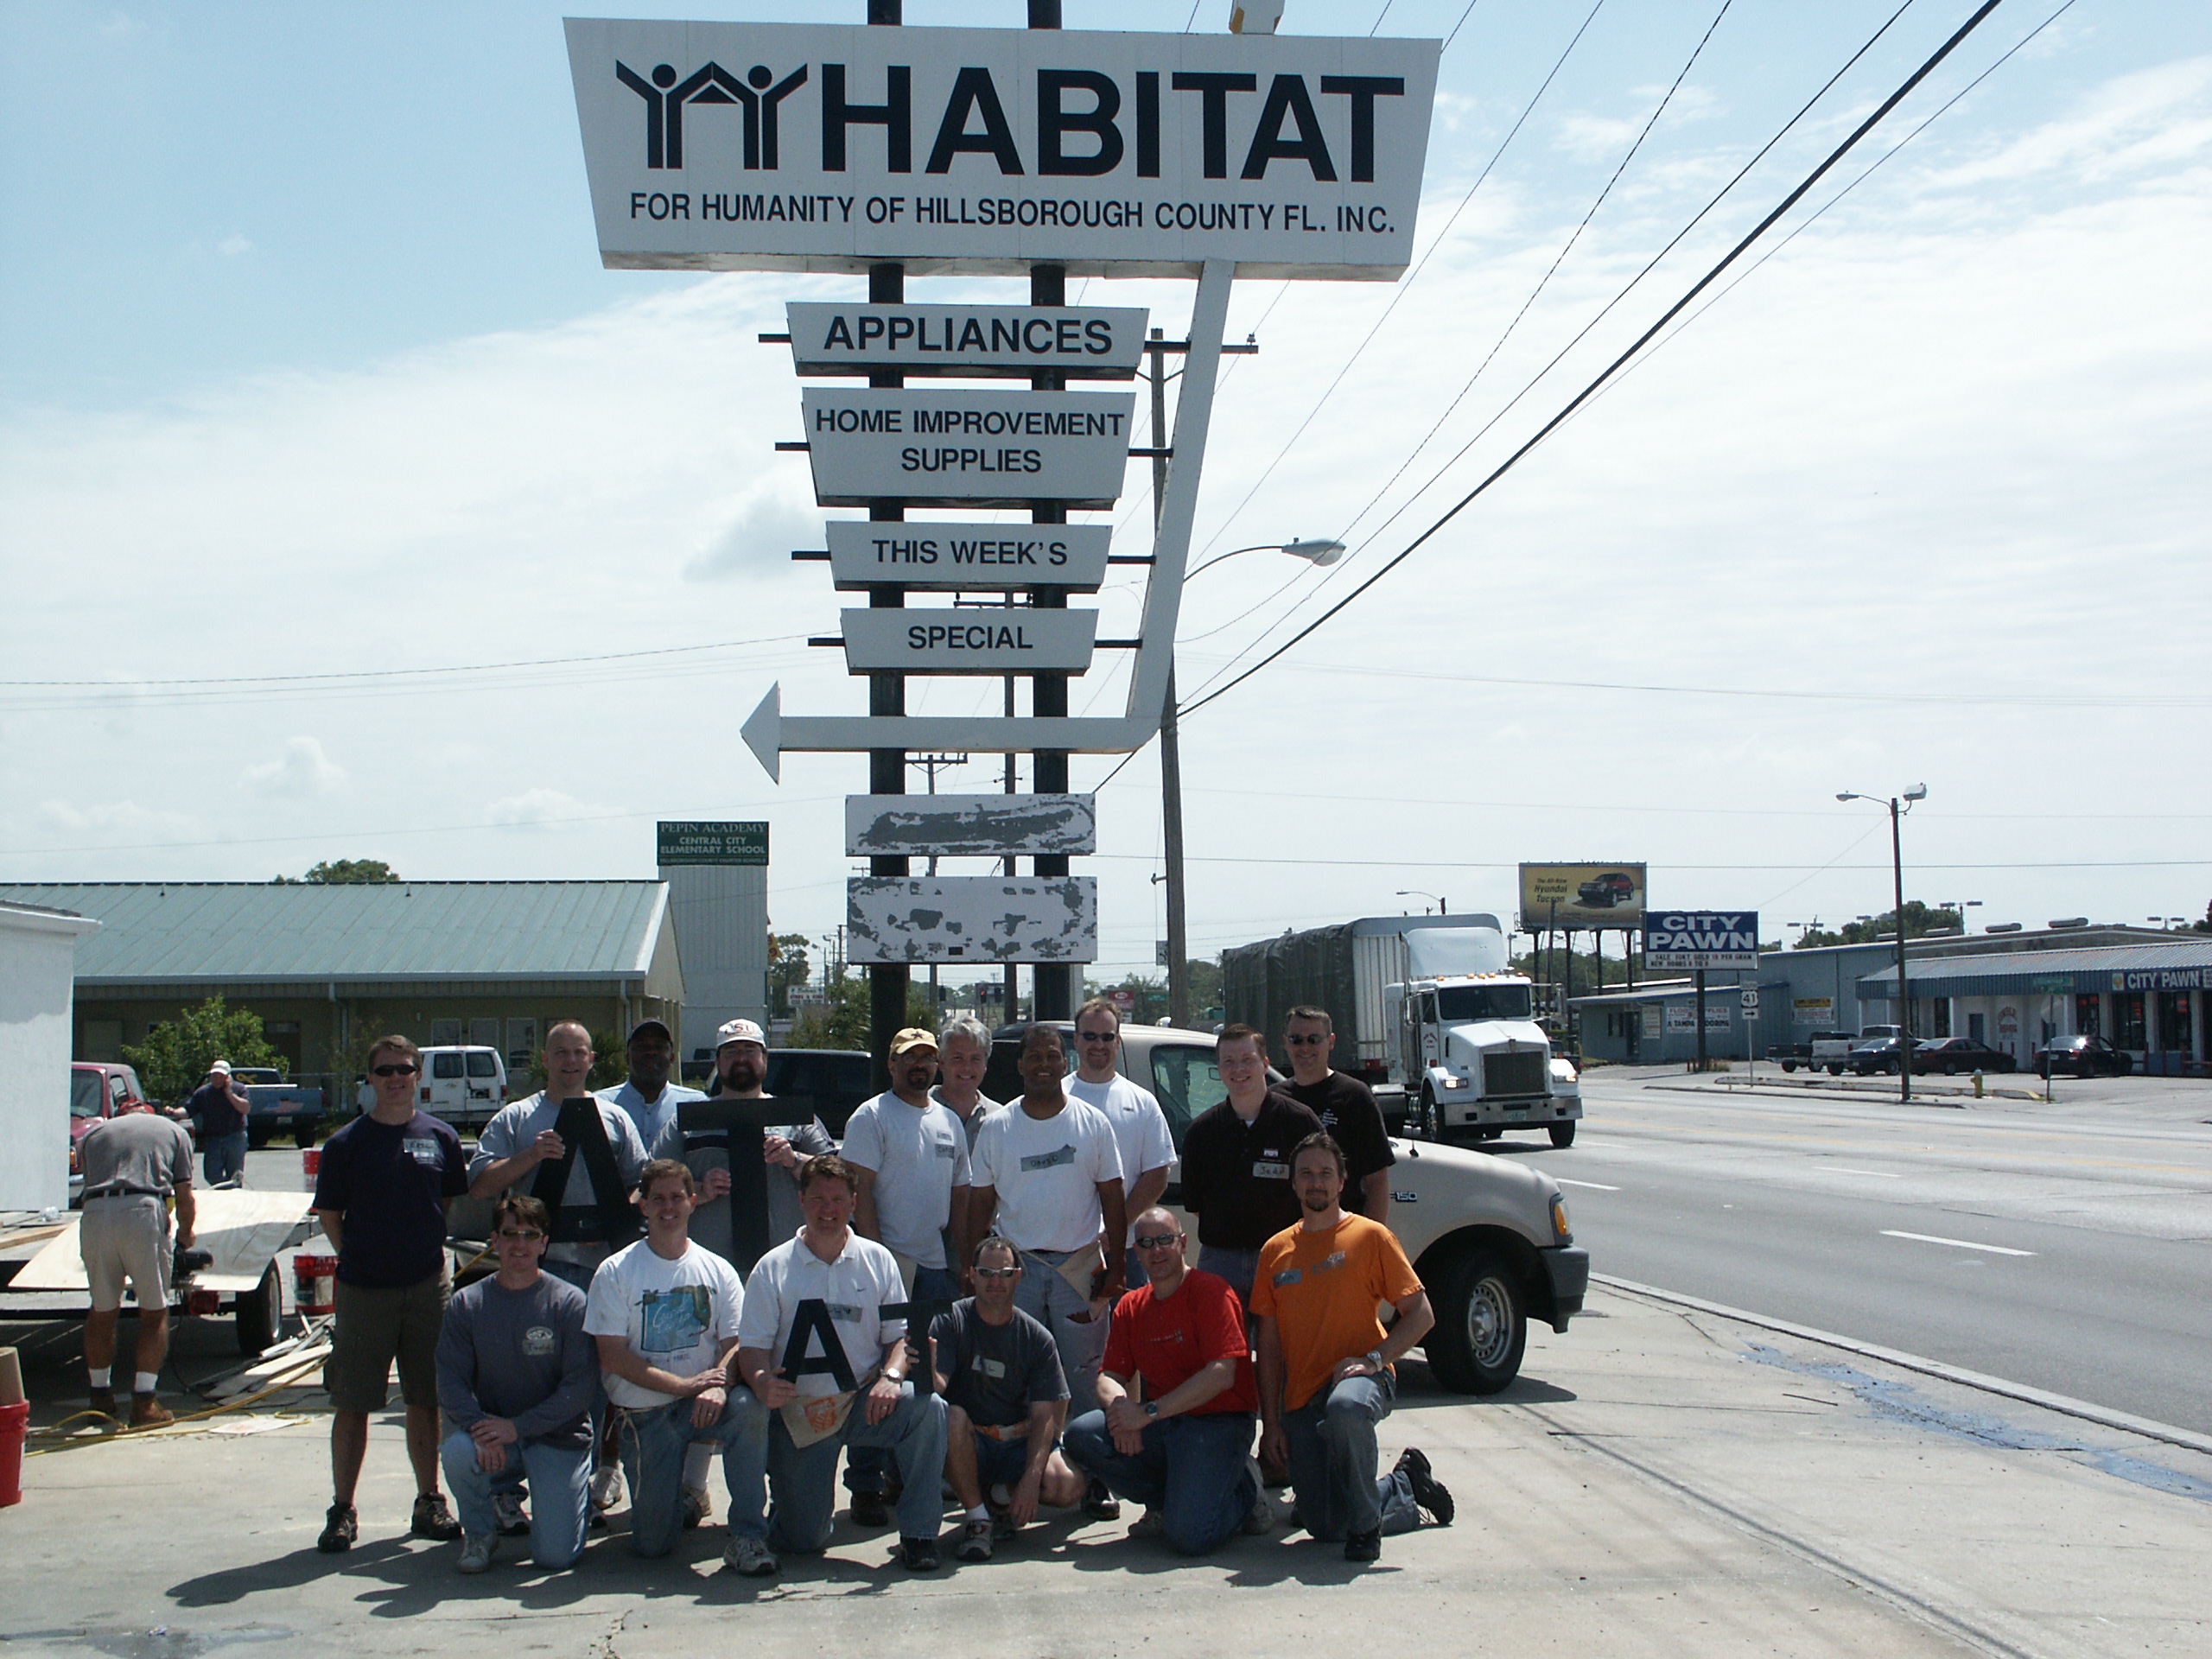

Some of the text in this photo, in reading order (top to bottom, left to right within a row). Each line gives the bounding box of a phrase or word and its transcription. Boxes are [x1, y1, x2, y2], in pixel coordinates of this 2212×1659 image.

[822, 63, 1405, 183] HABITAT
[630, 193, 1395, 233] FOR HUMANITY OF HILLSBOROUGH COUNTY FL. INC.
[823, 316, 1112, 355] APPLIANCES
[816, 409, 1126, 436] HOME IMPROVEMENT
[901, 448, 1042, 473] SUPPLIES
[872, 539, 1068, 566] THIS WEEK'S
[907, 626, 1033, 650] SPECIAL
[660, 823, 766, 833] PEPIN ACADEMY
[679, 836, 747, 845] CENTRAL CITY
[660, 846, 766, 855] ELEMENTARY SCHOOL
[1534, 884, 1567, 893] Hyundai
[1536, 894, 1565, 903] Tucson
[1662, 916, 1742, 931] CITY
[1649, 932, 1754, 950] PAWN
[2127, 972, 2158, 989] CITY
[2161, 970, 2200, 988] PAWN
[1743, 994, 1756, 1003] 41
[780, 1298, 860, 1391] A
